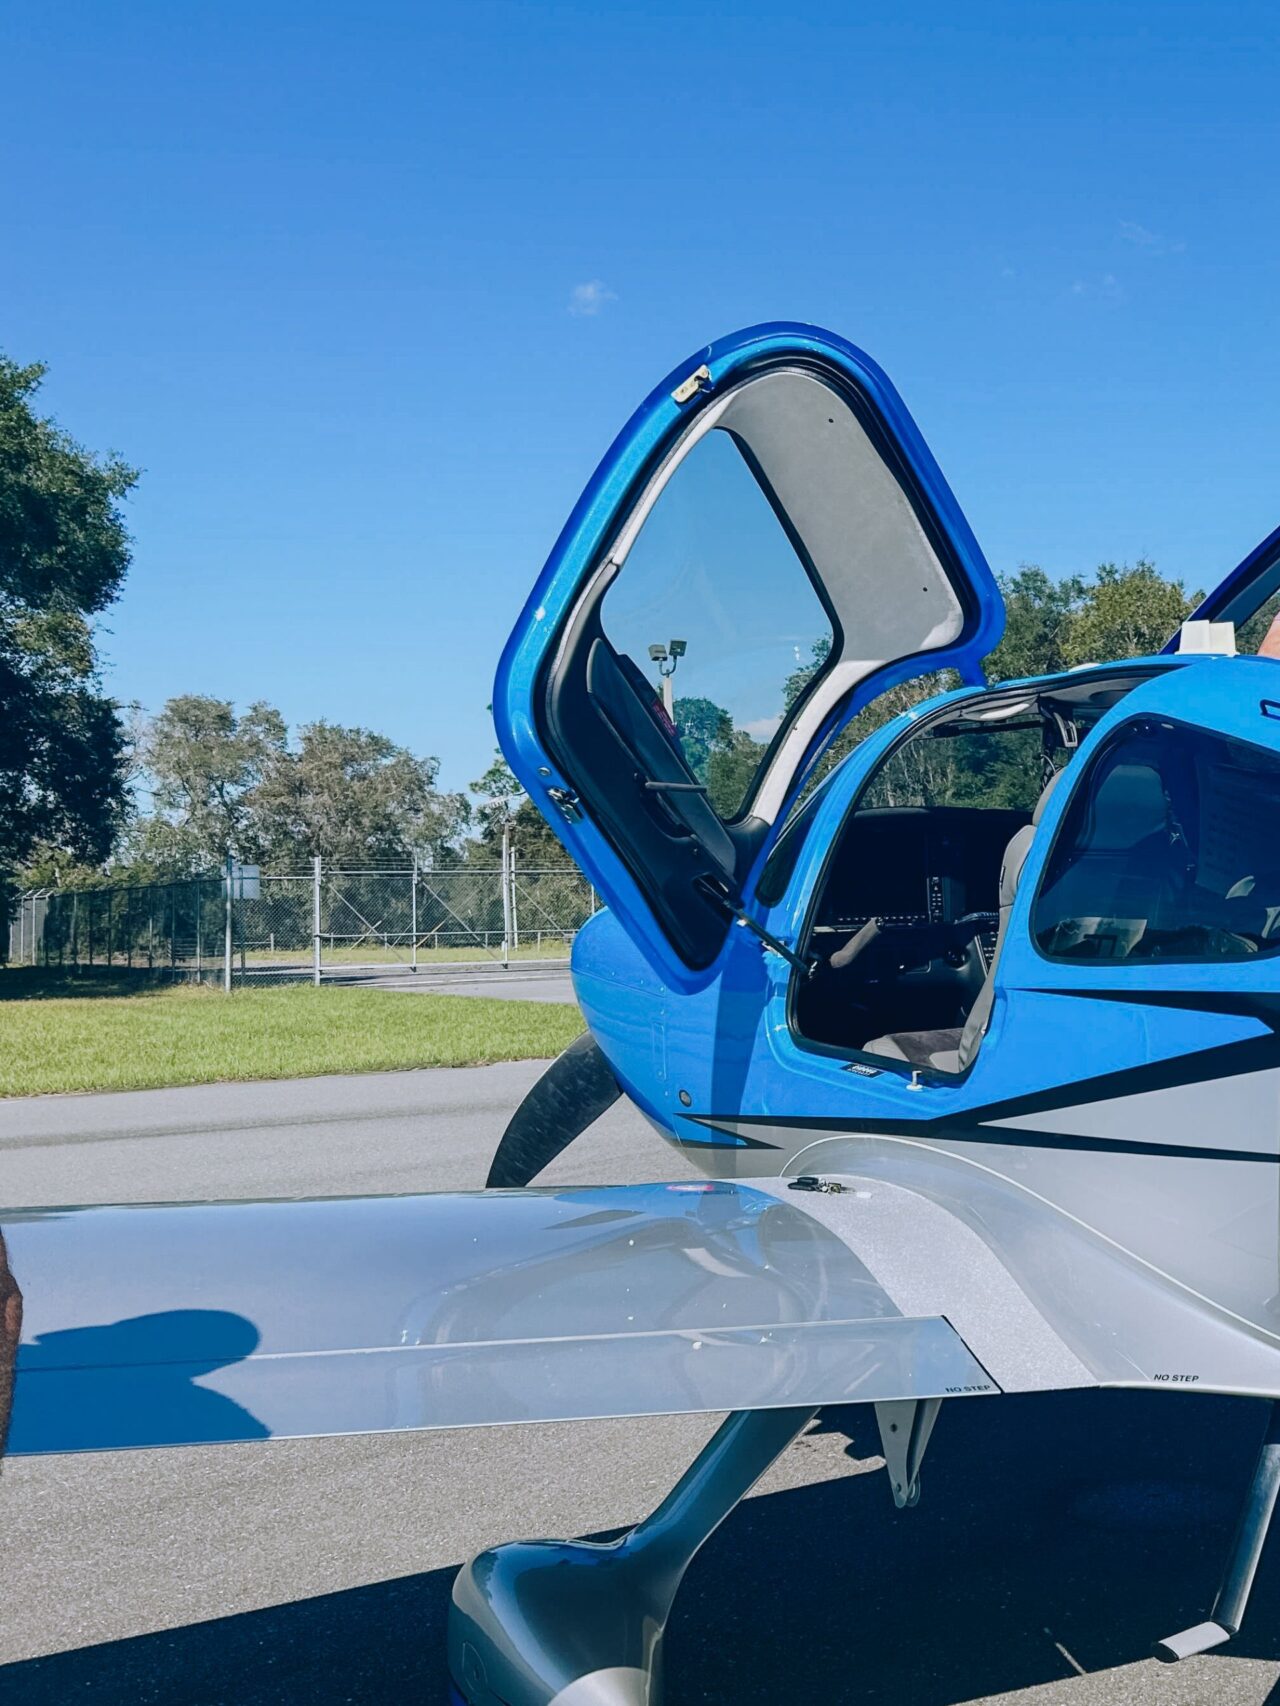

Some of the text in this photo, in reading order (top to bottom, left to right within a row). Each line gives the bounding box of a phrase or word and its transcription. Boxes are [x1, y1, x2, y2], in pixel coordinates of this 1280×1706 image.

[1153, 1373, 1199, 1382] NO STEP
[963, 1384, 991, 1392] STEP
